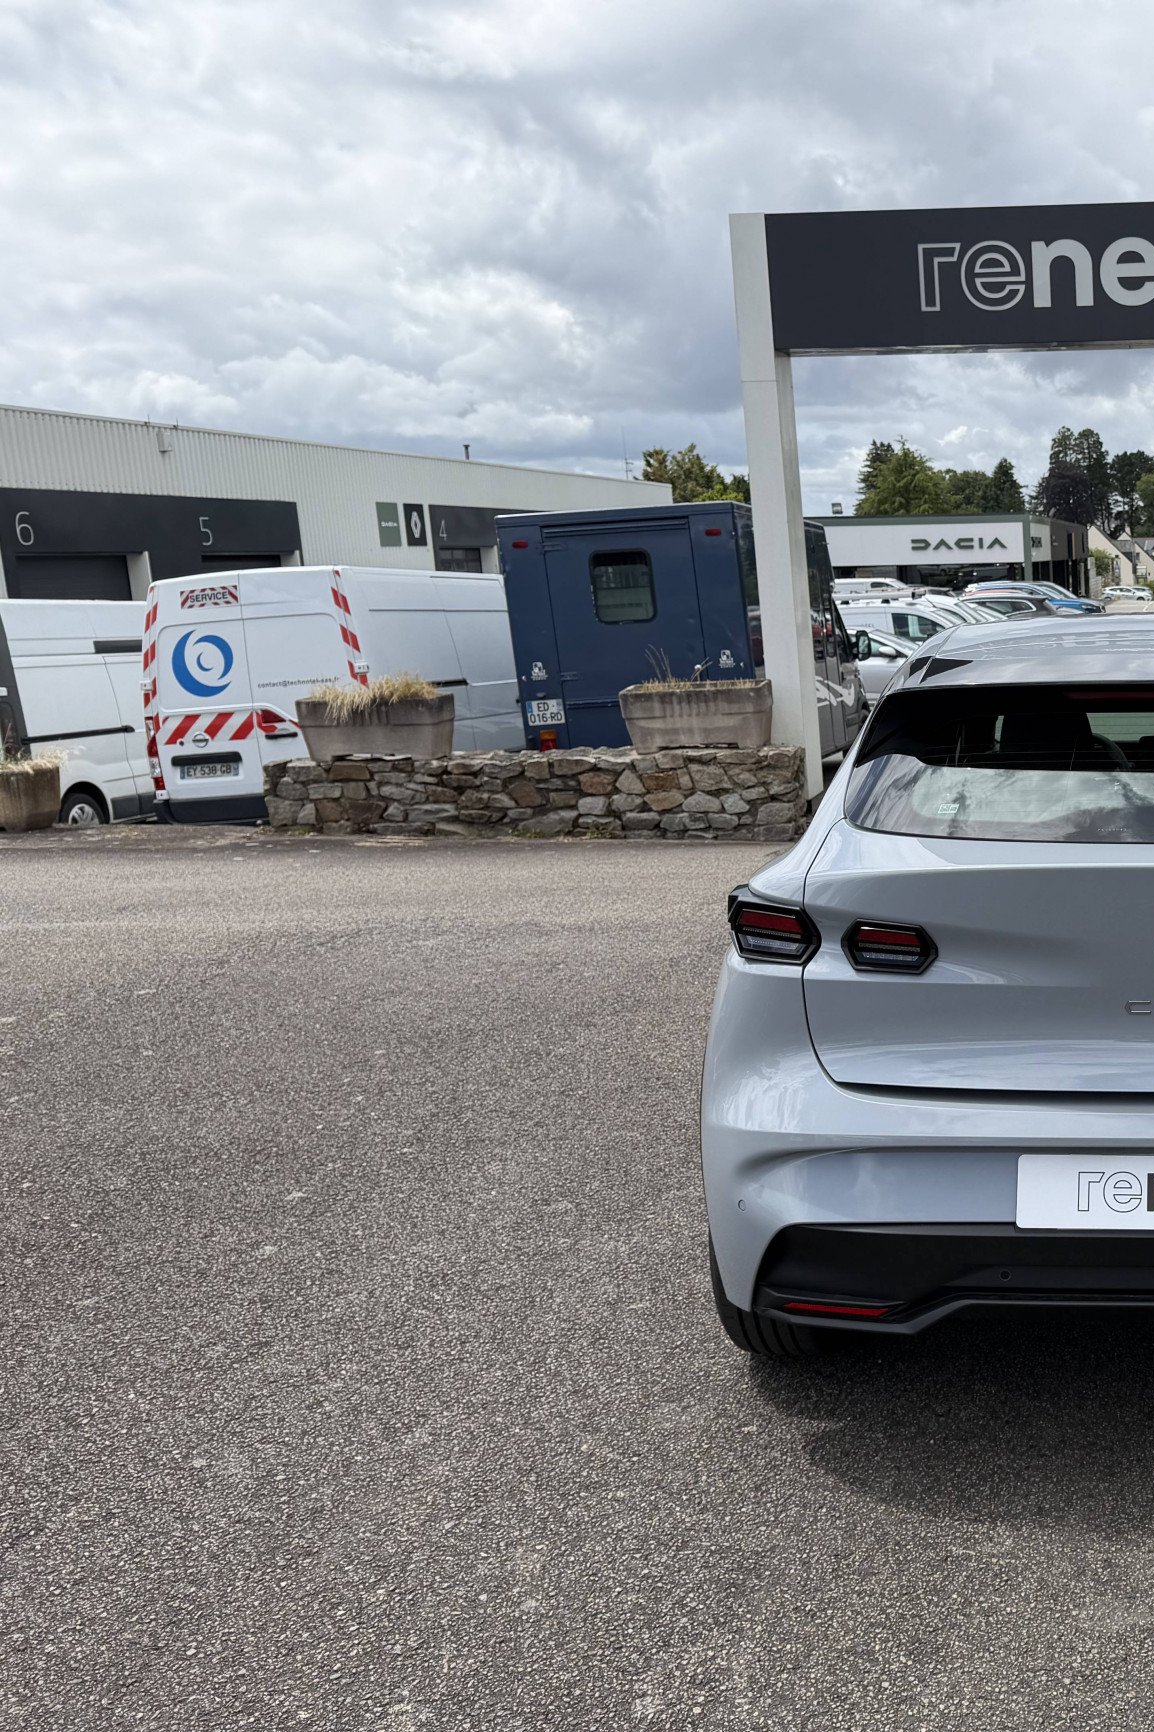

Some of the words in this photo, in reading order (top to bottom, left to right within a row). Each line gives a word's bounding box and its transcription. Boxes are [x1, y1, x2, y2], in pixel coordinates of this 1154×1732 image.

[15, 511, 34, 545] 6
[199, 516, 213, 546] 5
[439, 519, 448, 541] 4
[911, 537, 1008, 551] DACIA
[189, 591, 228, 603] SERVICE
